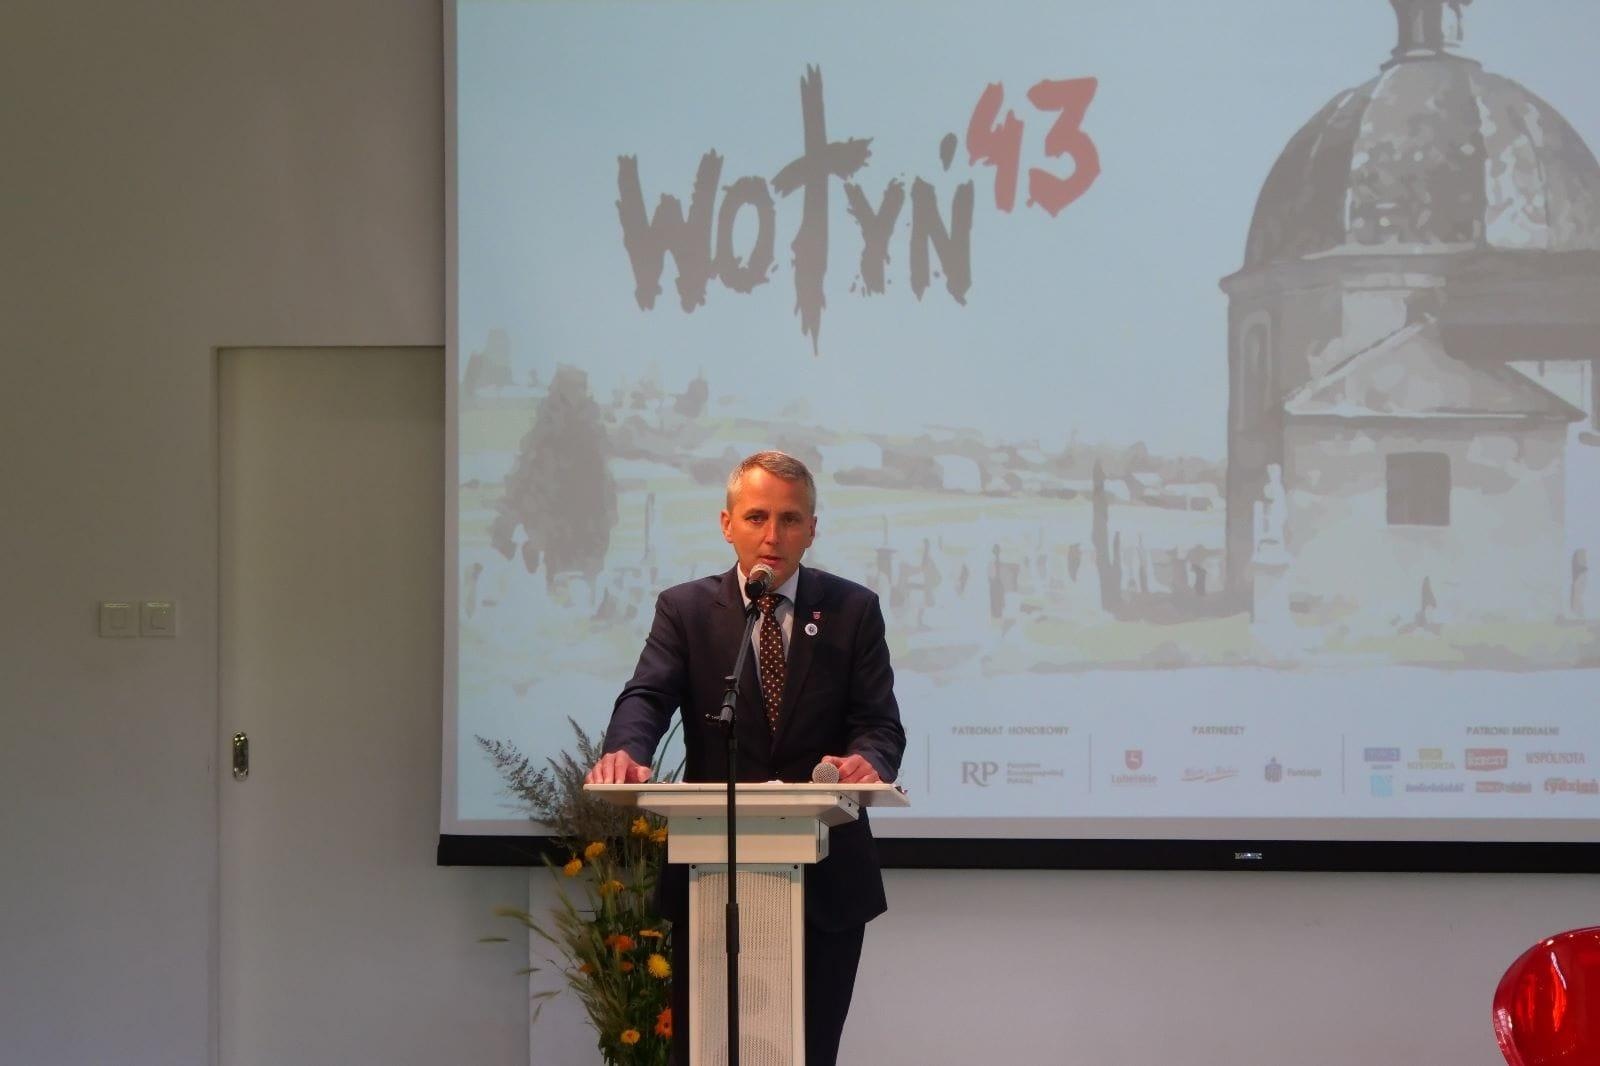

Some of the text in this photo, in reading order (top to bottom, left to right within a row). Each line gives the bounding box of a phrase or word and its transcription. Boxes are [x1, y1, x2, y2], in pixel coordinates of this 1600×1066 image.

[951, 726, 1069, 736] PATRONAT HONOROWY
[1192, 726, 1246, 736] PARTNERZY
[1466, 726, 1560, 736] PATRONI MEDIALNI
[961, 761, 999, 787] RP
